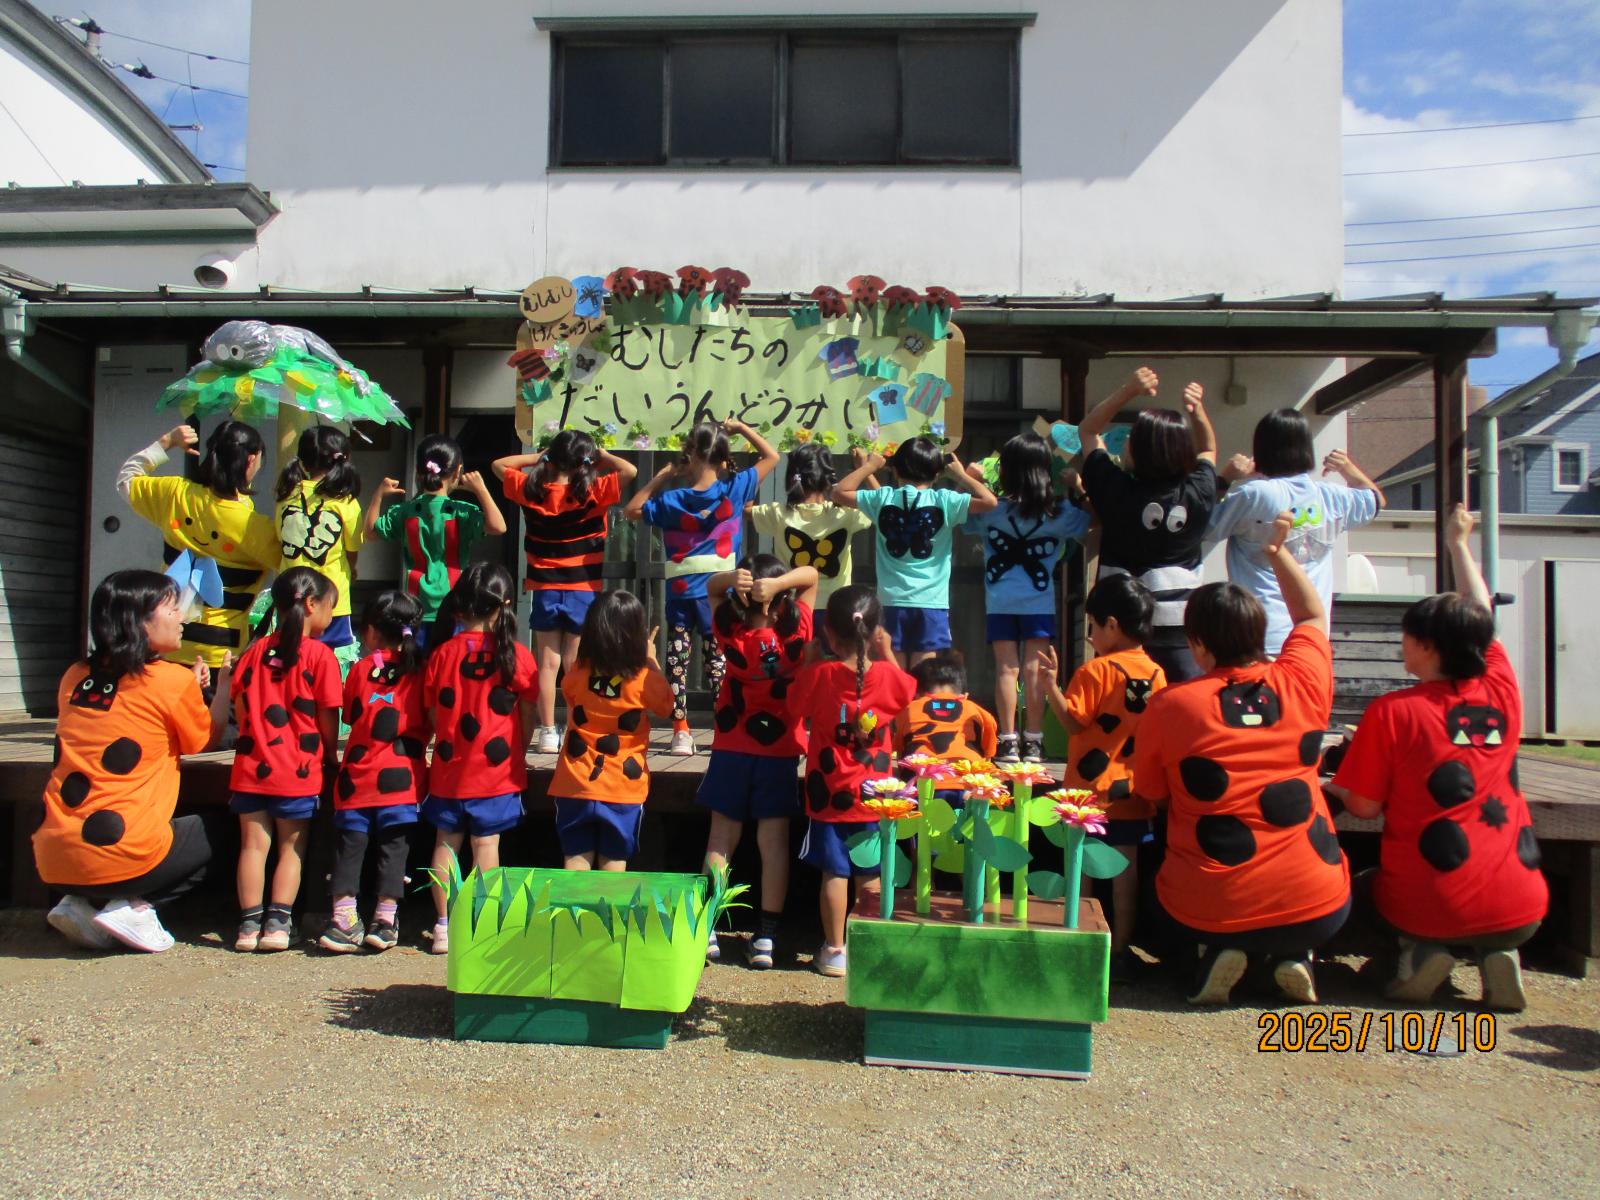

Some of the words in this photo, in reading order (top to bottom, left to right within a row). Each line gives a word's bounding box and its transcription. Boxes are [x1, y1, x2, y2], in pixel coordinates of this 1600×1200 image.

[523, 285, 573, 312] むしむし
[610, 324, 788, 370] むしたちの
[560, 381, 876, 431] だいうんどうかい
